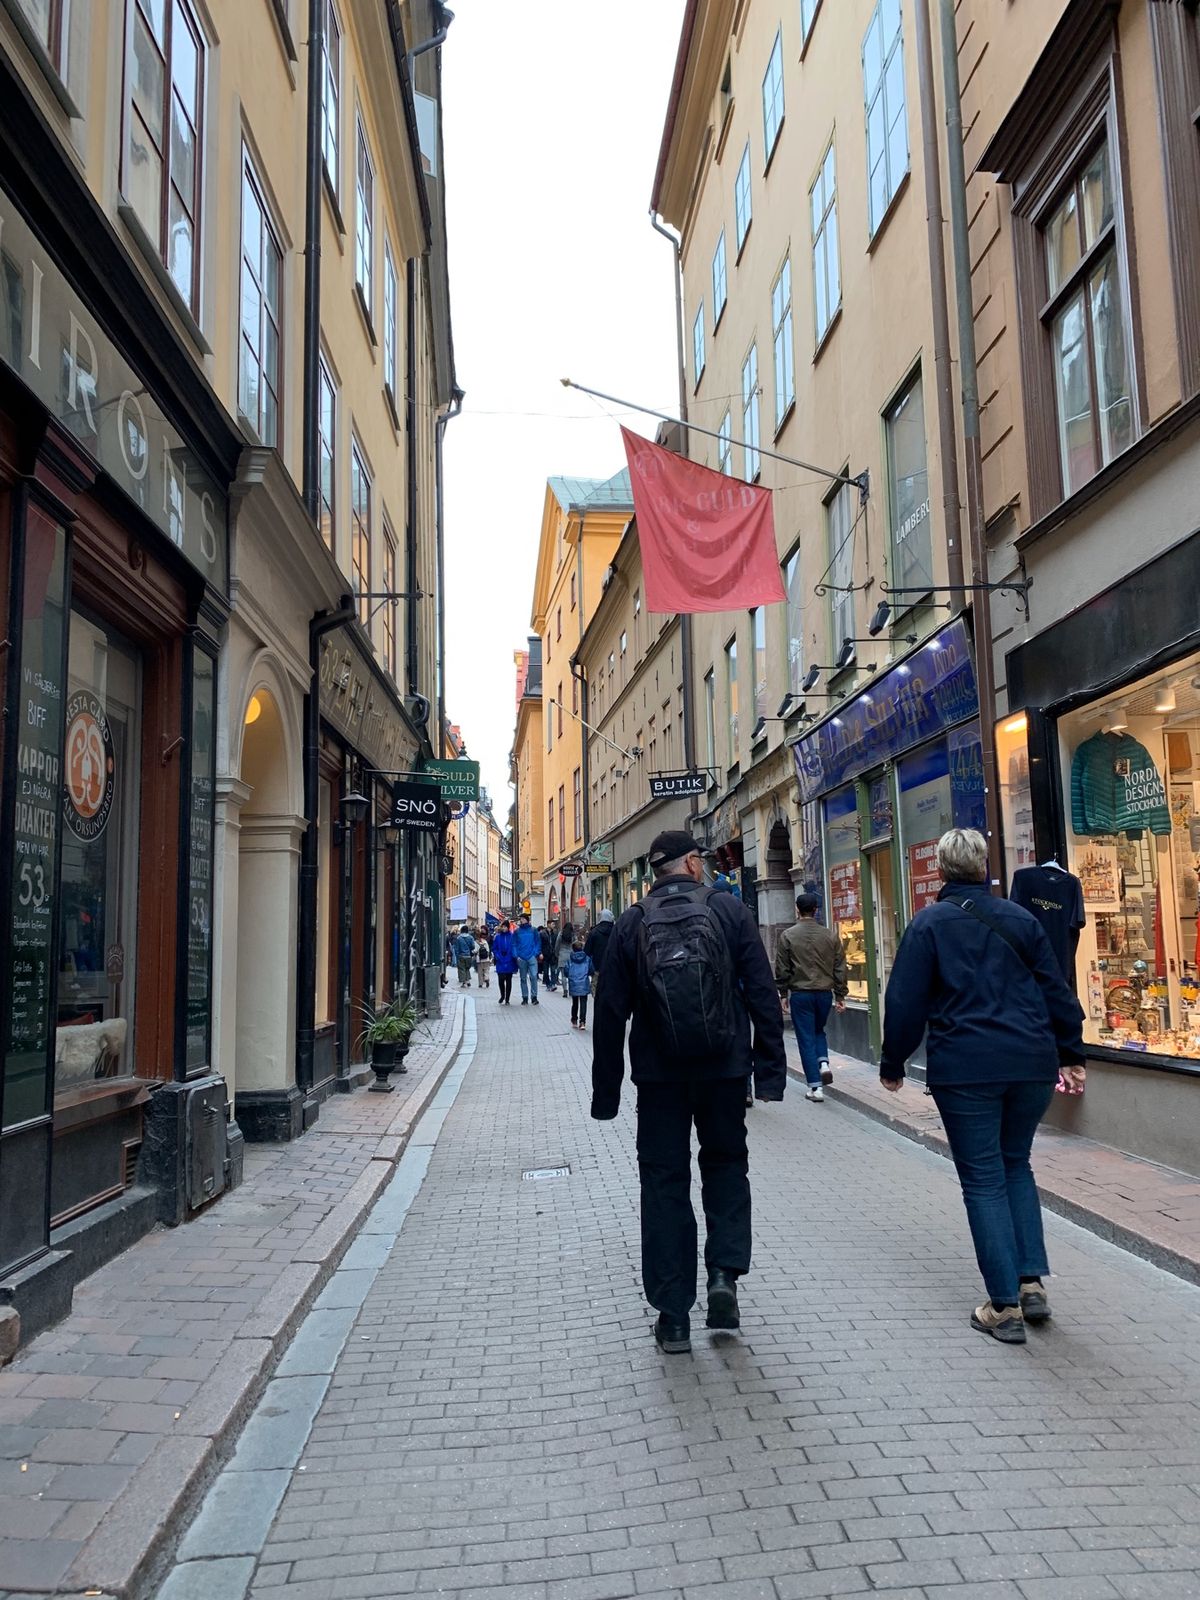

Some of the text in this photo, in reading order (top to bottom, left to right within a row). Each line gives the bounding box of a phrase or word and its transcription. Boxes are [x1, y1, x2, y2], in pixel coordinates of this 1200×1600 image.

[0, 216, 216, 564] IRONS
[696, 486, 756, 511] GULD
[932, 644, 957, 676] INDO
[27, 700, 47, 729] BIFF
[441, 771, 475, 782] GULD
[654, 778, 702, 791] BUTIK
[440, 785, 475, 796] ILVER
[1125, 779, 1166, 802] DESIGNS
[396, 799, 437, 815] SNÖ
[1126, 795, 1167, 814] STOCKHOLM
[14, 799, 56, 839] DRÄKTER
[406, 818, 436, 828] SWEDEN
[19, 863, 45, 906] 53
